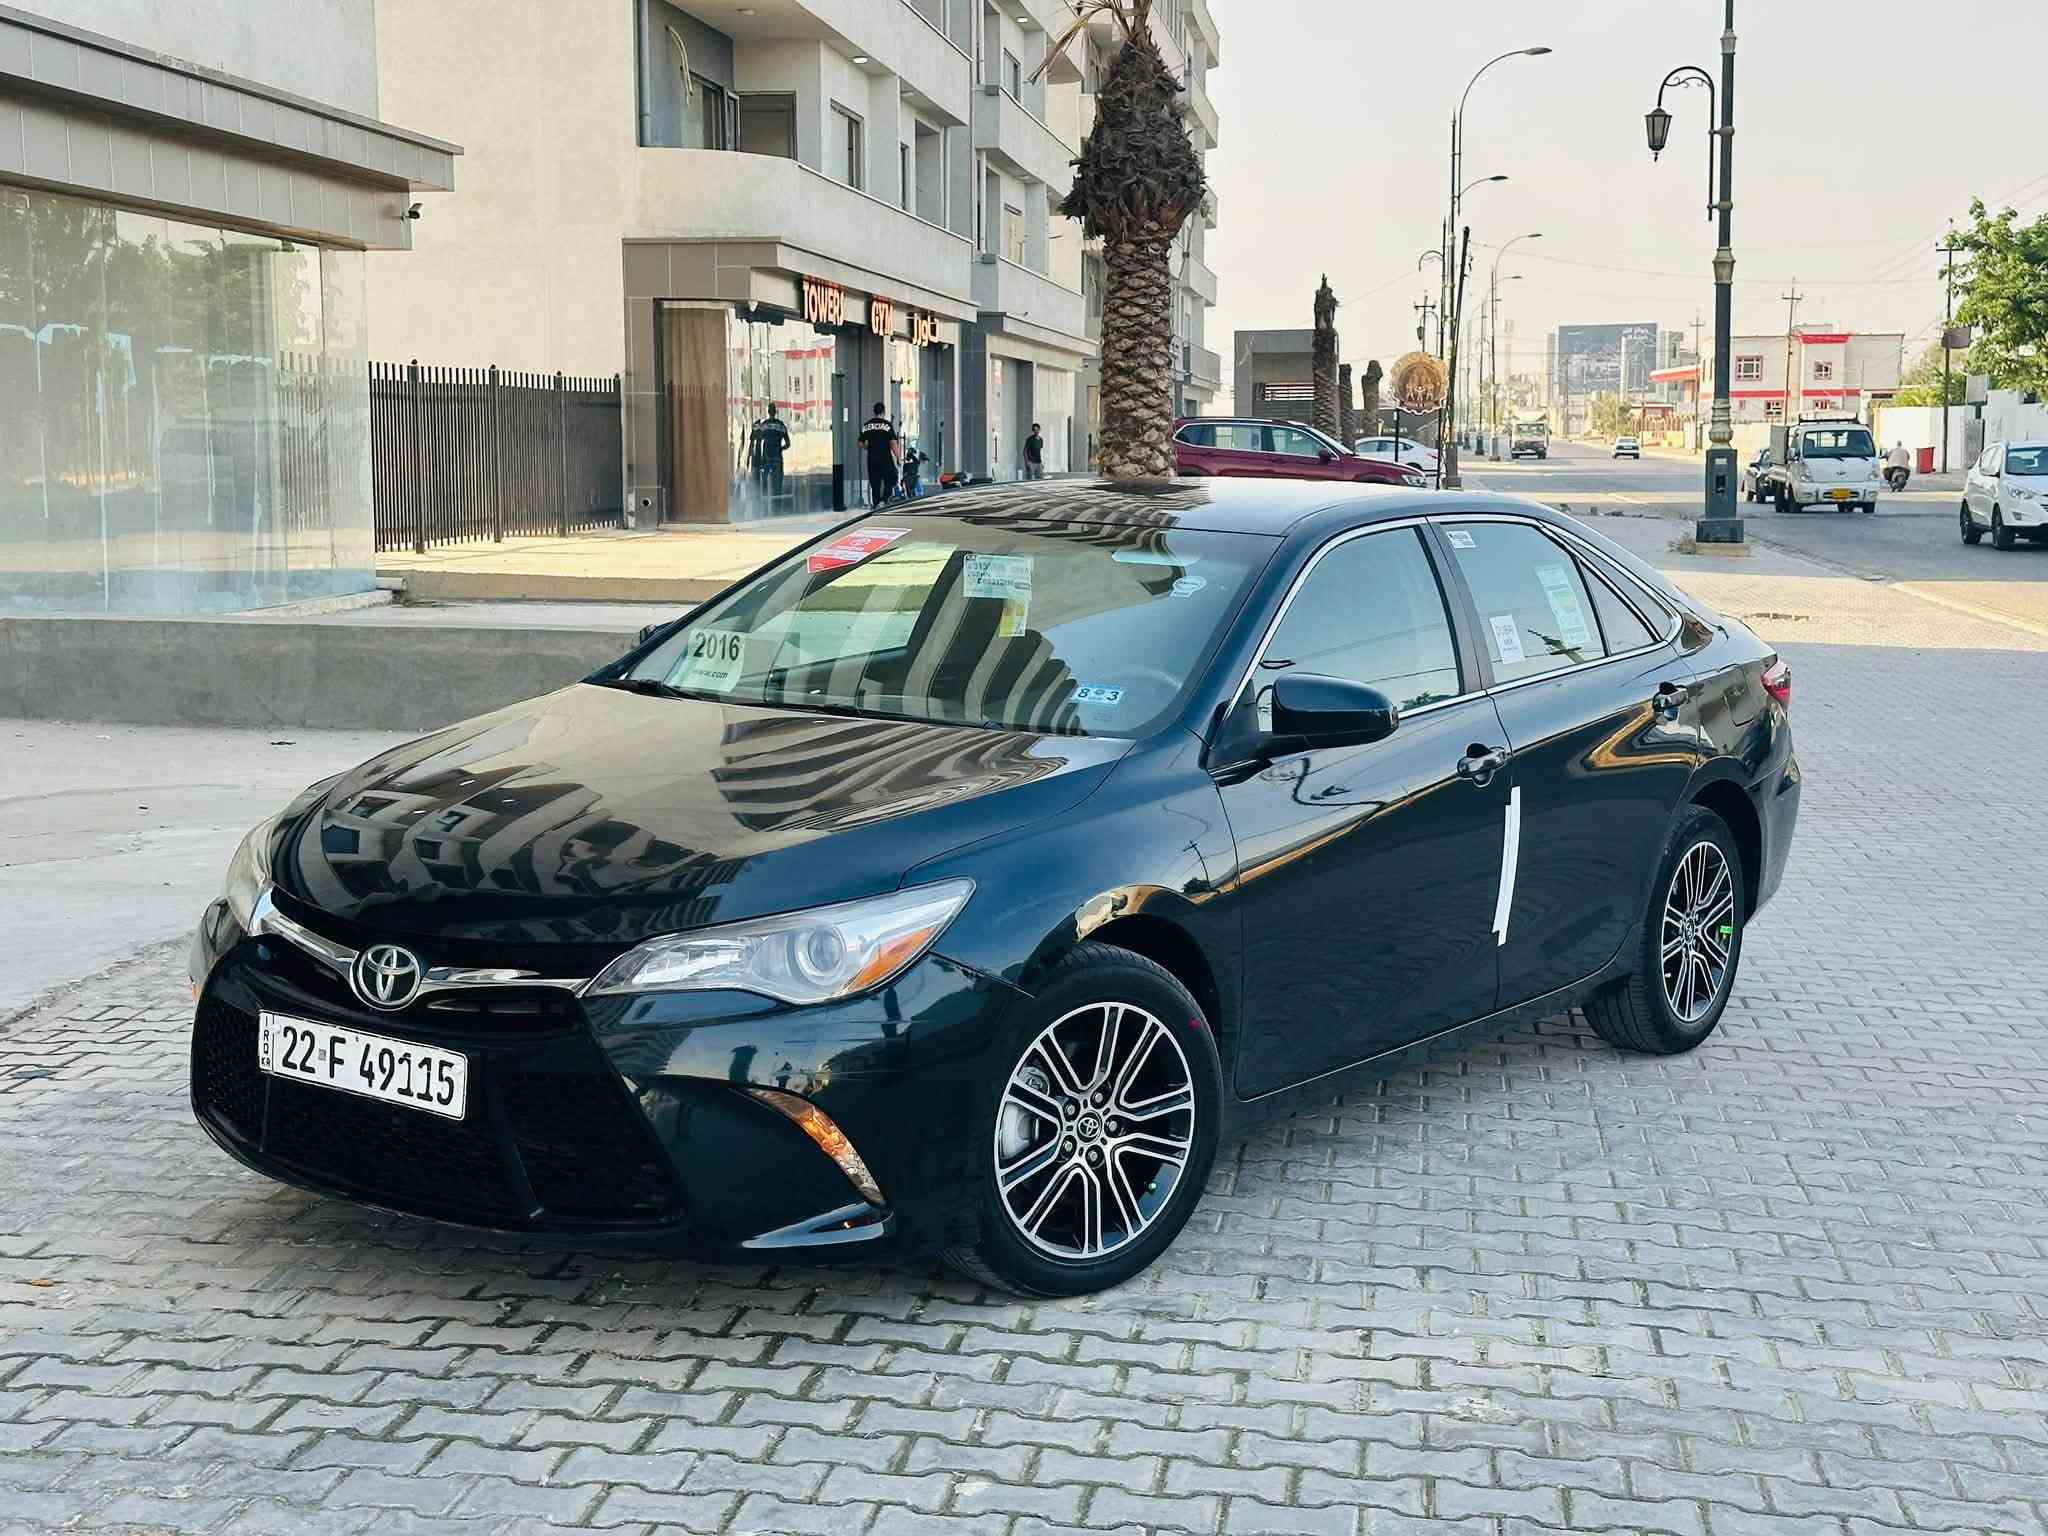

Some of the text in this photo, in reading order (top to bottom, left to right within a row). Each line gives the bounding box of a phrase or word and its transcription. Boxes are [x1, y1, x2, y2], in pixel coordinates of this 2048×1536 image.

[803, 279, 895, 337] TOWERS GYM
[693, 631, 740, 661] 2016
[1106, 691, 1119, 701] 3
[282, 1026, 456, 1106] 22 F 49115
